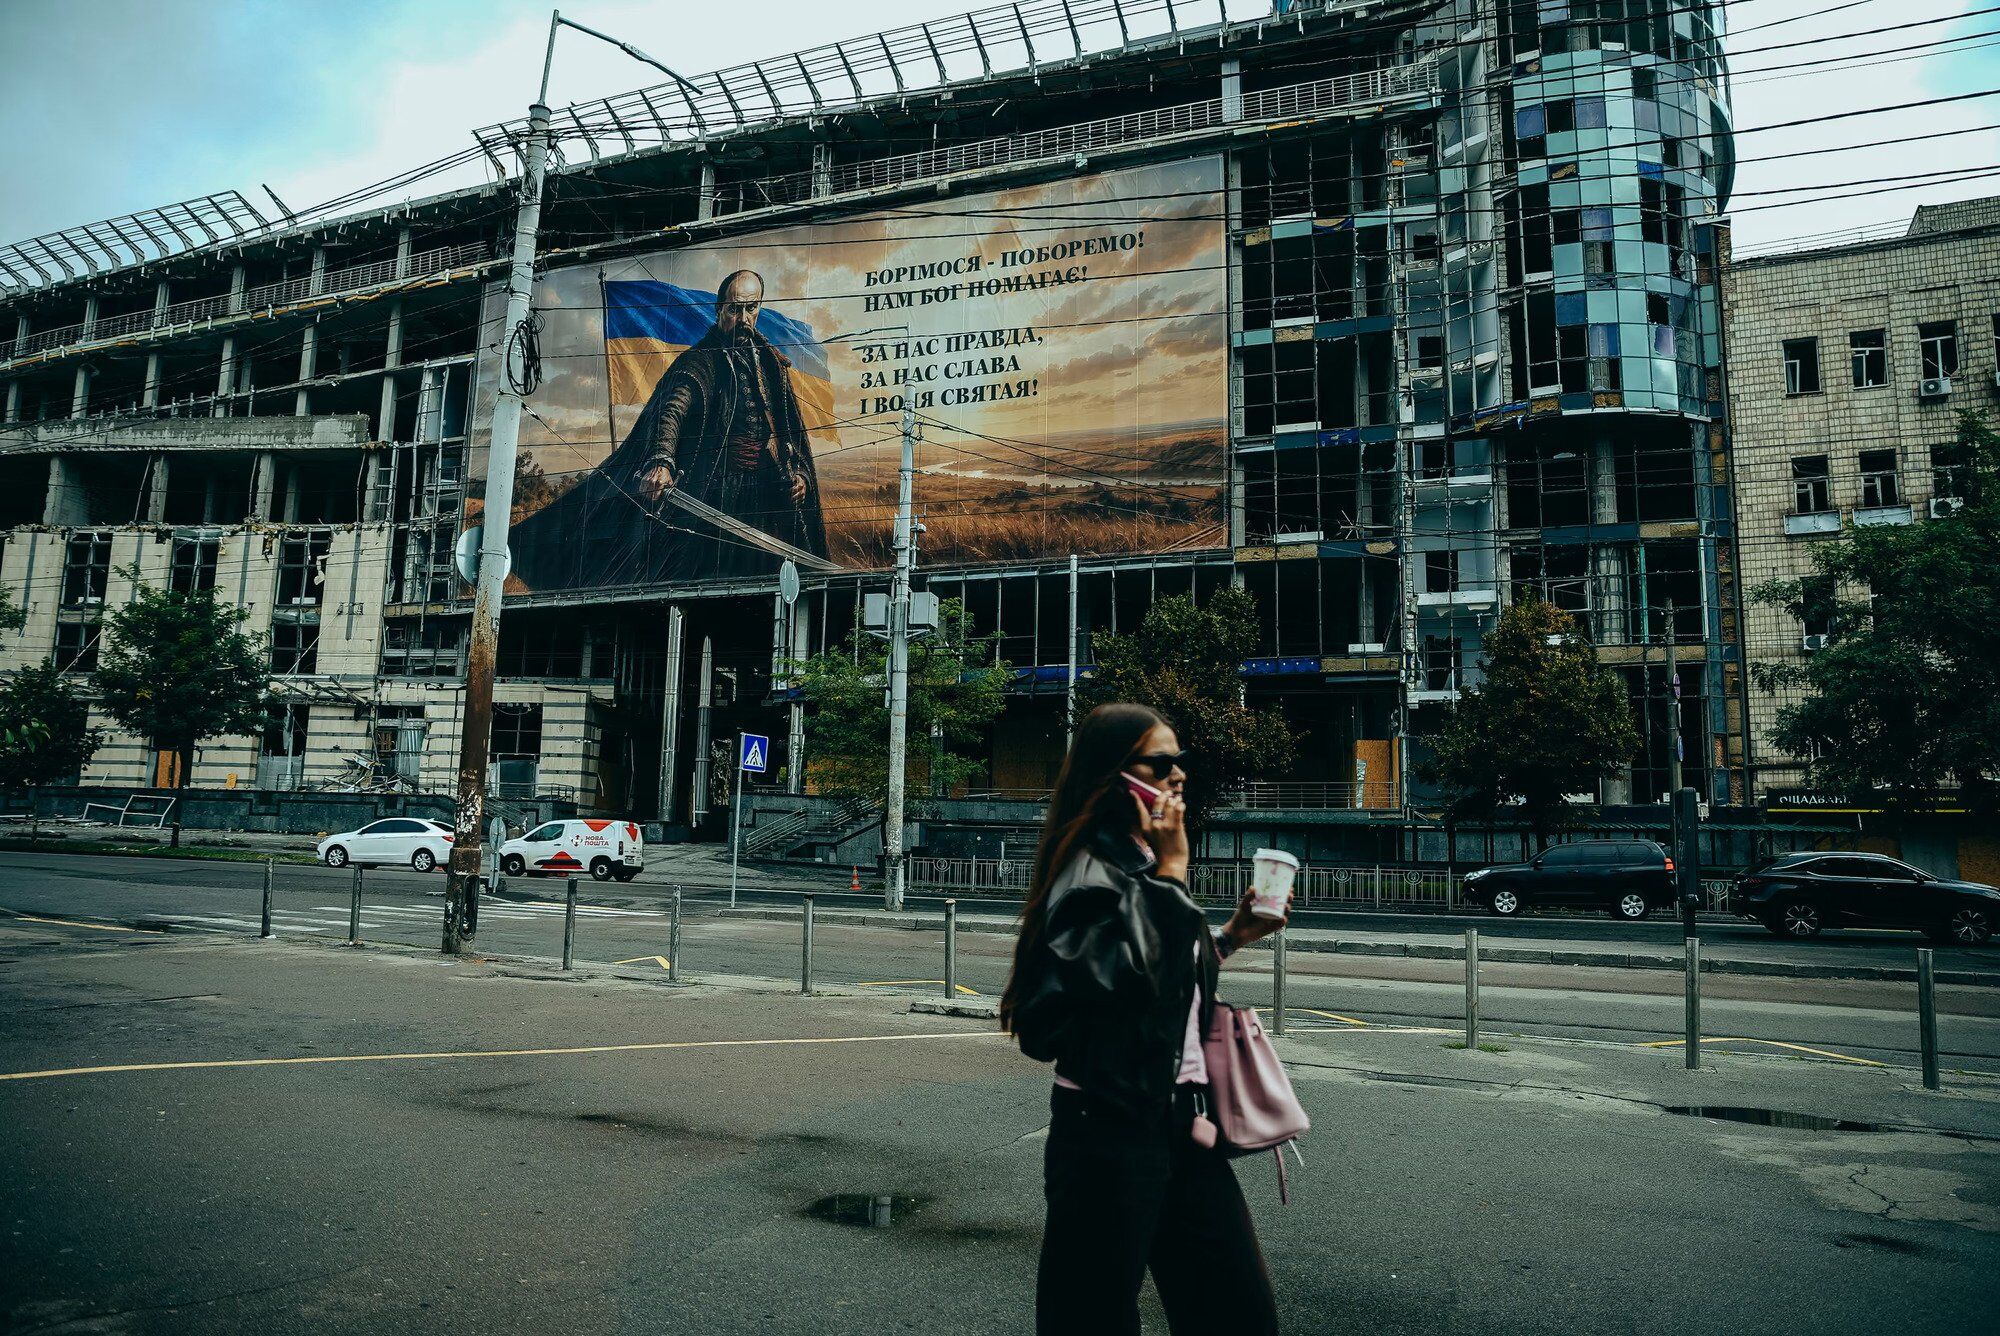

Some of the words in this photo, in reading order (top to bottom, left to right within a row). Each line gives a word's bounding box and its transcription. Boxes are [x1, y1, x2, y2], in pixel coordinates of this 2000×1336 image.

[864, 255, 982, 288] БОРІМОСЯ
[1000, 231, 1145, 268] ПОБОРЕМО!
[864, 291, 914, 313] НАМ
[920, 283, 963, 305] БОГ
[967, 265, 1088, 298] ПОМАГАЄ!
[861, 344, 889, 363] ЗА
[894, 338, 939, 360] НАС
[945, 327, 1043, 353] ПРАВДА,
[860, 371, 888, 389] ЗА
[893, 364, 938, 386] НАС
[944, 354, 1021, 379] СЛАВА
[860, 398, 868, 415] І
[941, 379, 1038, 406] СВЯТАЯ!
